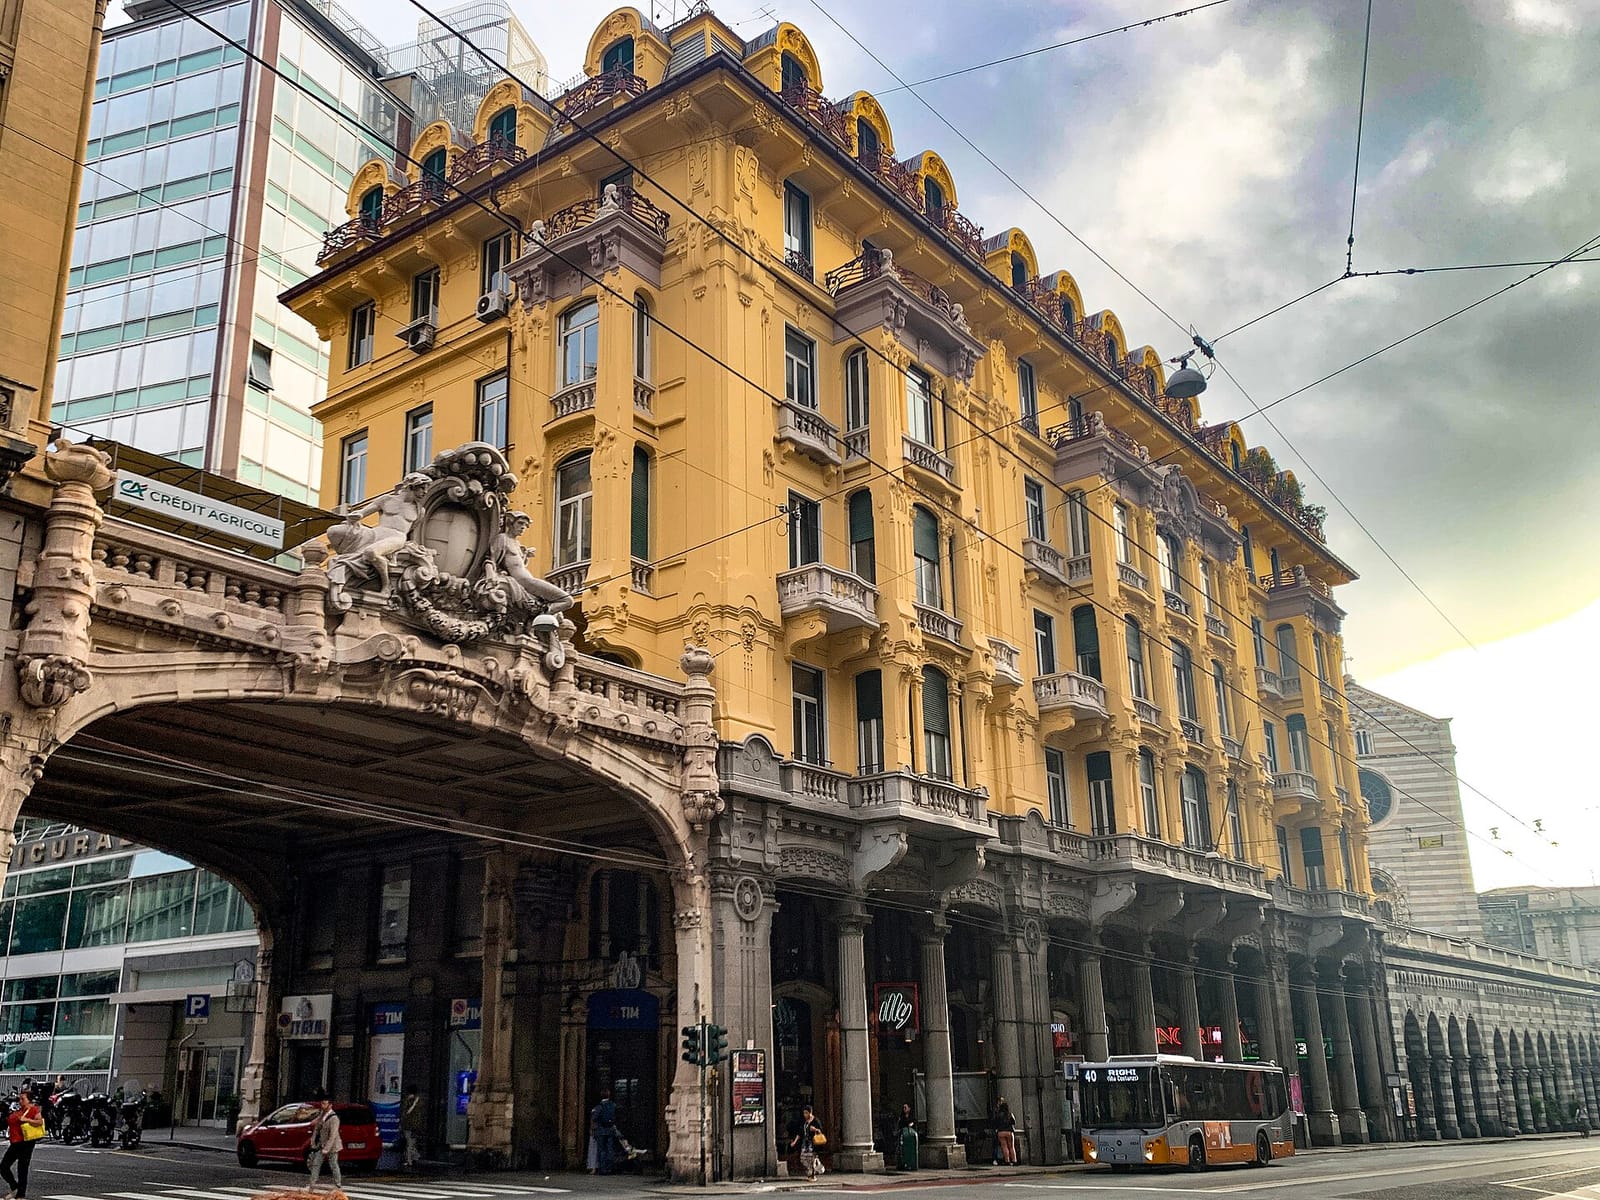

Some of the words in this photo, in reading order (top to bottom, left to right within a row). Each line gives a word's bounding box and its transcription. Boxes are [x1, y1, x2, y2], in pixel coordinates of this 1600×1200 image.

[150, 491, 206, 517] CRÉDIT
[207, 509, 281, 539] AGRICOLE
[17, 832, 134, 866] ICURA
[190, 996, 206, 1015] P
[620, 1006, 640, 1020] TIM
[878, 992, 913, 1030] illy
[385, 1012, 402, 1024] TIM
[21, 1032, 50, 1041] PROGRESS
[1085, 1070, 1097, 1082] 40
